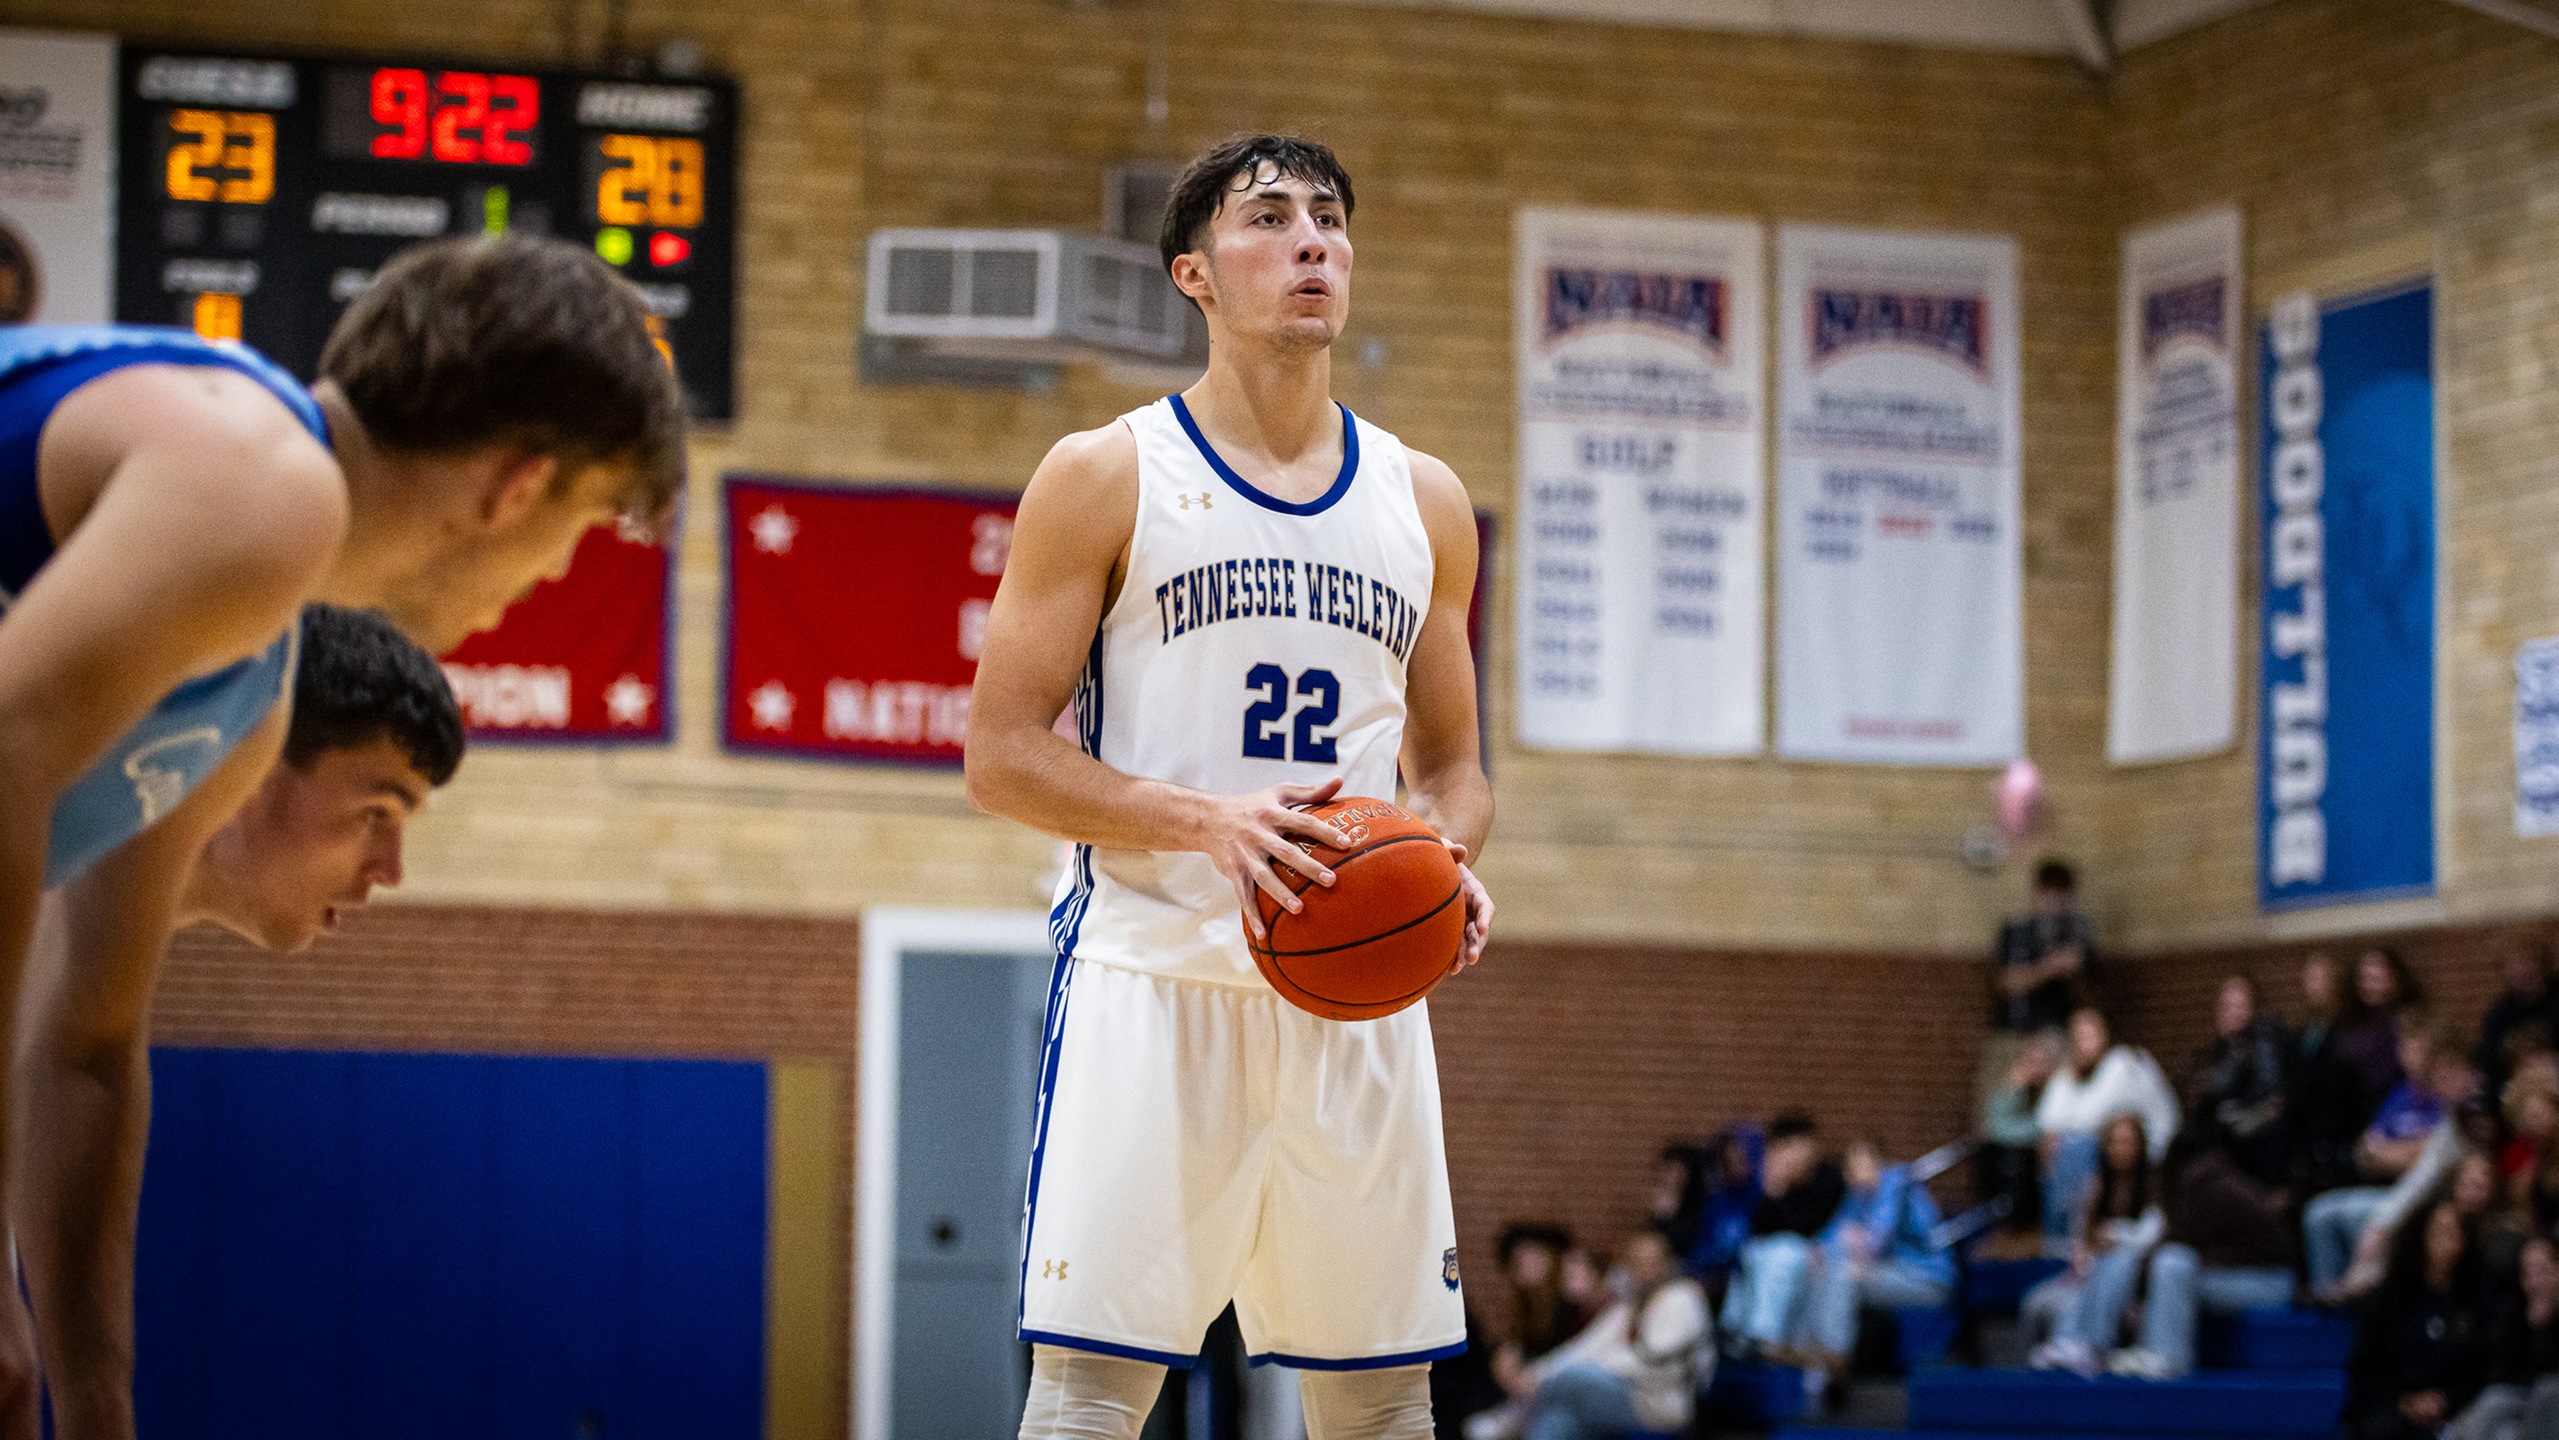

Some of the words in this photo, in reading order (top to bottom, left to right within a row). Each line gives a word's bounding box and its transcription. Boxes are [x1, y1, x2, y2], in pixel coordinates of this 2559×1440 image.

[166, 109, 277, 204] 23
[599, 134, 705, 227] 28
[1155, 557, 1298, 647] TENNESSEE
[2271, 292, 2327, 888] BULLDOGS
[1242, 661, 1342, 765] 22
[1326, 803, 1411, 829] SPALD
